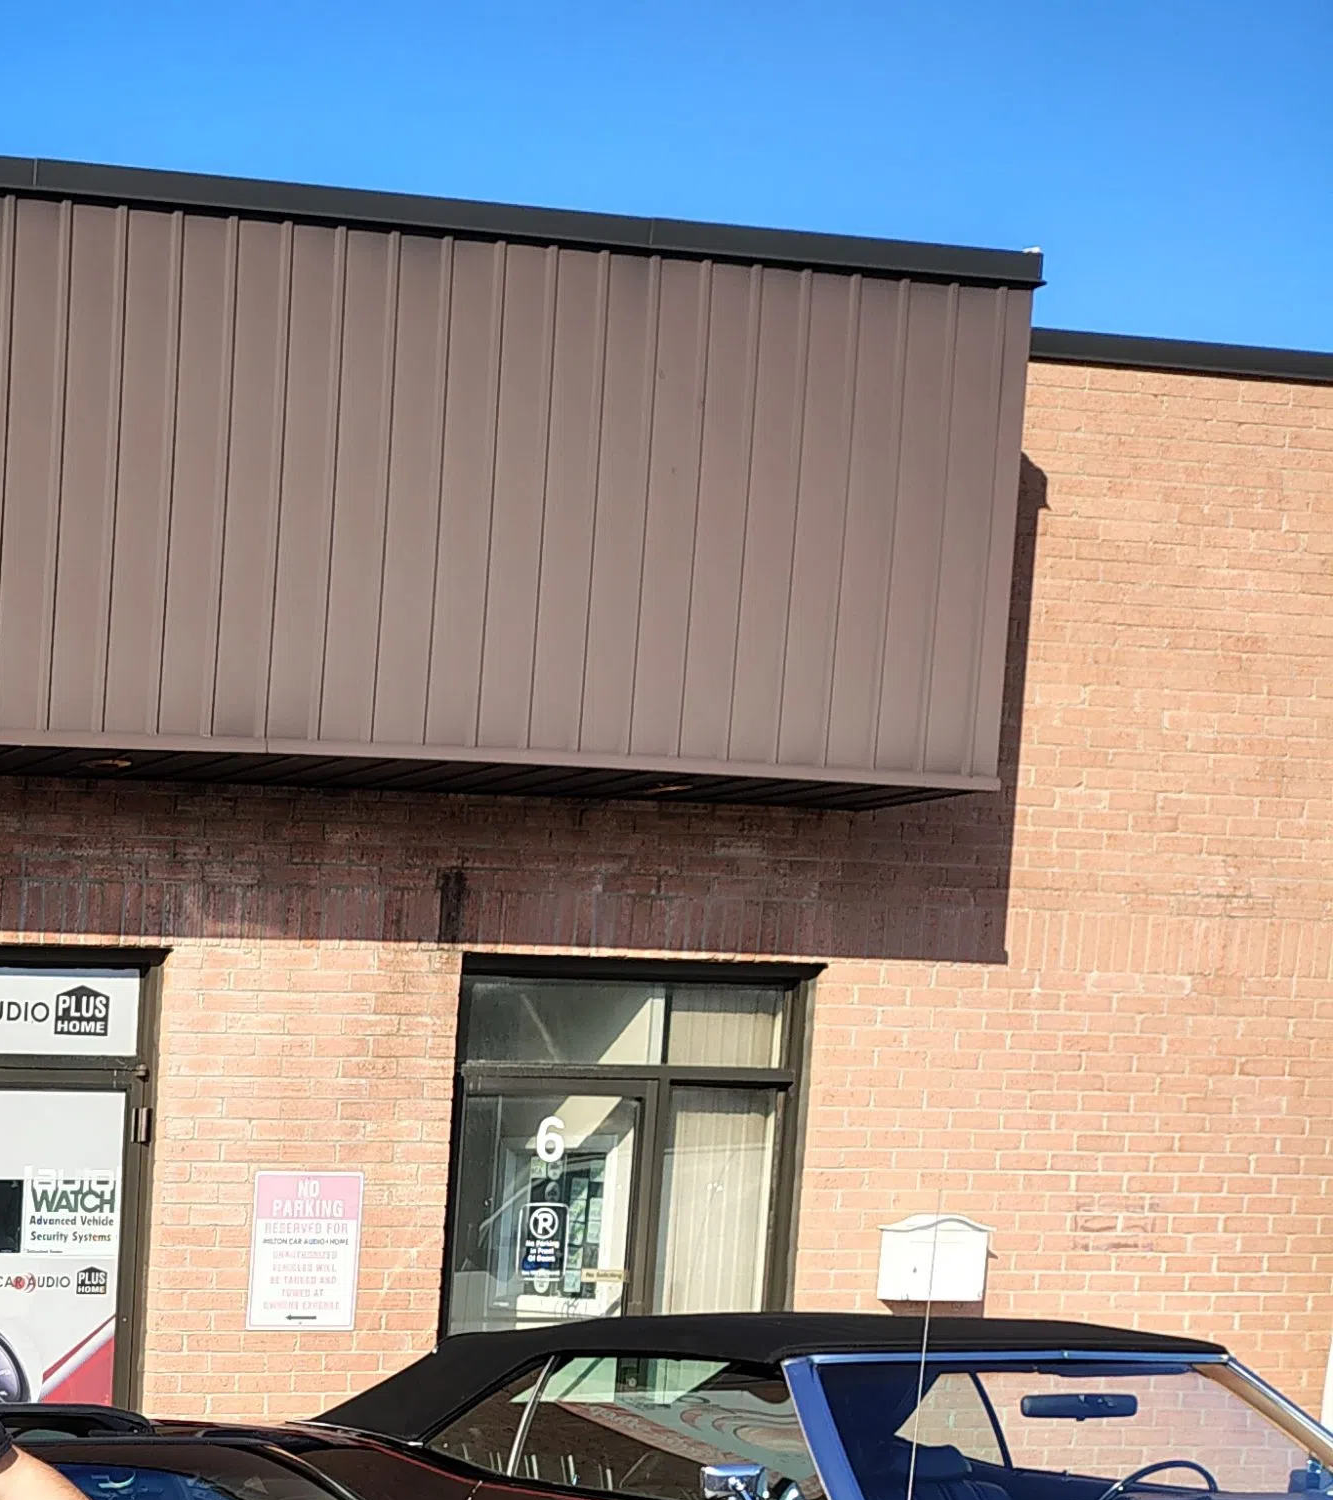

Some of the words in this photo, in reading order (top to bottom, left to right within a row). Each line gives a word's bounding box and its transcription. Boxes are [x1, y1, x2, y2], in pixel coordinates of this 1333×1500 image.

[57, 995, 107, 1019] PLUS
[56, 1020, 106, 1034] HOME
[536, 1115, 565, 1163] 6
[297, 1179, 320, 1198] NO
[31, 1189, 116, 1213] WATCH
[272, 1199, 345, 1218] PARKING
[29, 1215, 77, 1226] Advanced
[80, 1215, 114, 1226] Vehicle
[264, 1223, 322, 1235] RESERVED
[326, 1223, 349, 1235] FOR
[30, 1231, 69, 1243] Security
[72, 1231, 111, 1243] Systems
[26, 1276, 71, 1288] AUDIO
[77, 1272, 106, 1284] PLUS
[77, 1285, 106, 1293] HOME
